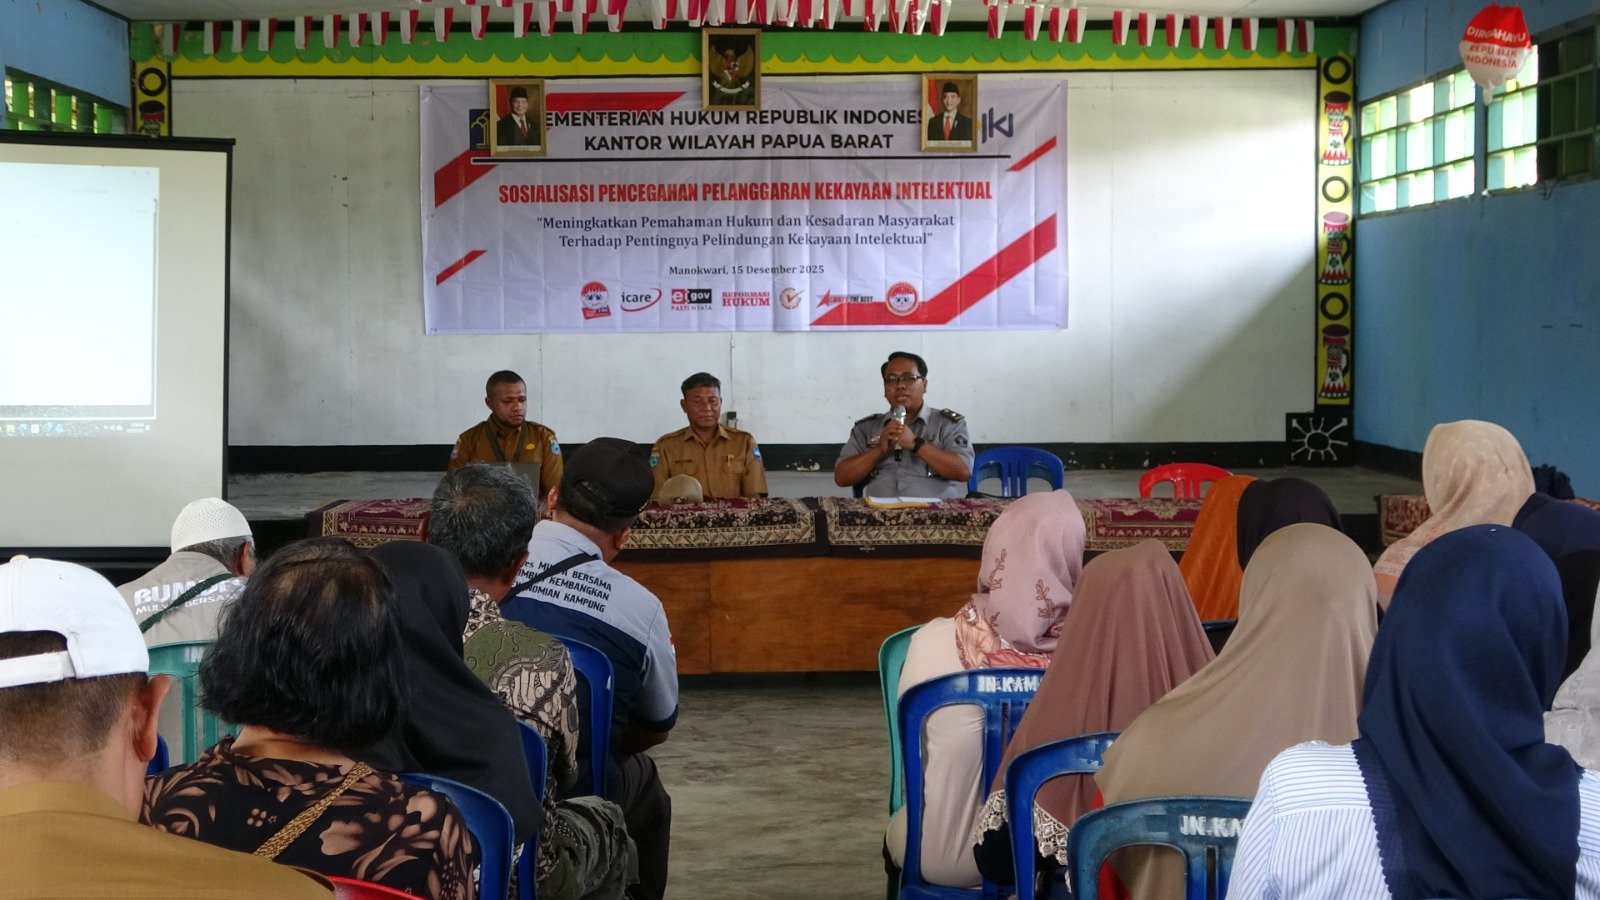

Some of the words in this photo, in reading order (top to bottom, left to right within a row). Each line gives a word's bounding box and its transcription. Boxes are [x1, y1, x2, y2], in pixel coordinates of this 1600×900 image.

[546, 111, 664, 127] EMENTERIAN
[671, 110, 740, 126] HUKUM
[747, 109, 839, 125] REPUBLIK
[584, 135, 663, 151] KANTOR
[668, 134, 755, 150] WILAYAH
[762, 134, 826, 149] PAPUA
[831, 133, 893, 149] BARAT
[498, 183, 595, 203] SOSIALISASI
[599, 183, 699, 203] PENCEGAHAN
[702, 181, 811, 202] PELANGGARAN
[815, 181, 892, 201] KEKAYAAN
[896, 181, 993, 200] INTELEKTUAL
[537, 216, 638, 231] “Meningkatkan
[641, 215, 723, 229] Pemahaman
[726, 214, 774, 228] Hukum
[777, 214, 802, 227] dan
[805, 214, 875, 227] Kesadaran
[878, 213, 955, 229] Masyarakat
[559, 235, 622, 250] Terhadap
[626, 233, 699, 249] Pentingnya
[702, 233, 784, 248] Pelindungan
[788, 233, 851, 248] Kekayaan
[669, 266, 729, 276] Manokwari,
[731, 266, 744, 275] 15
[747, 265, 797, 275] Desember
[799, 264, 825, 275] 2025
[621, 291, 652, 303] icare
[722, 297, 770, 307] HUKUM
[549, 576, 610, 601] KEMBANGKAN
[572, 570, 612, 592] BERSAMA
[563, 593, 606, 613] KAMPUNG
